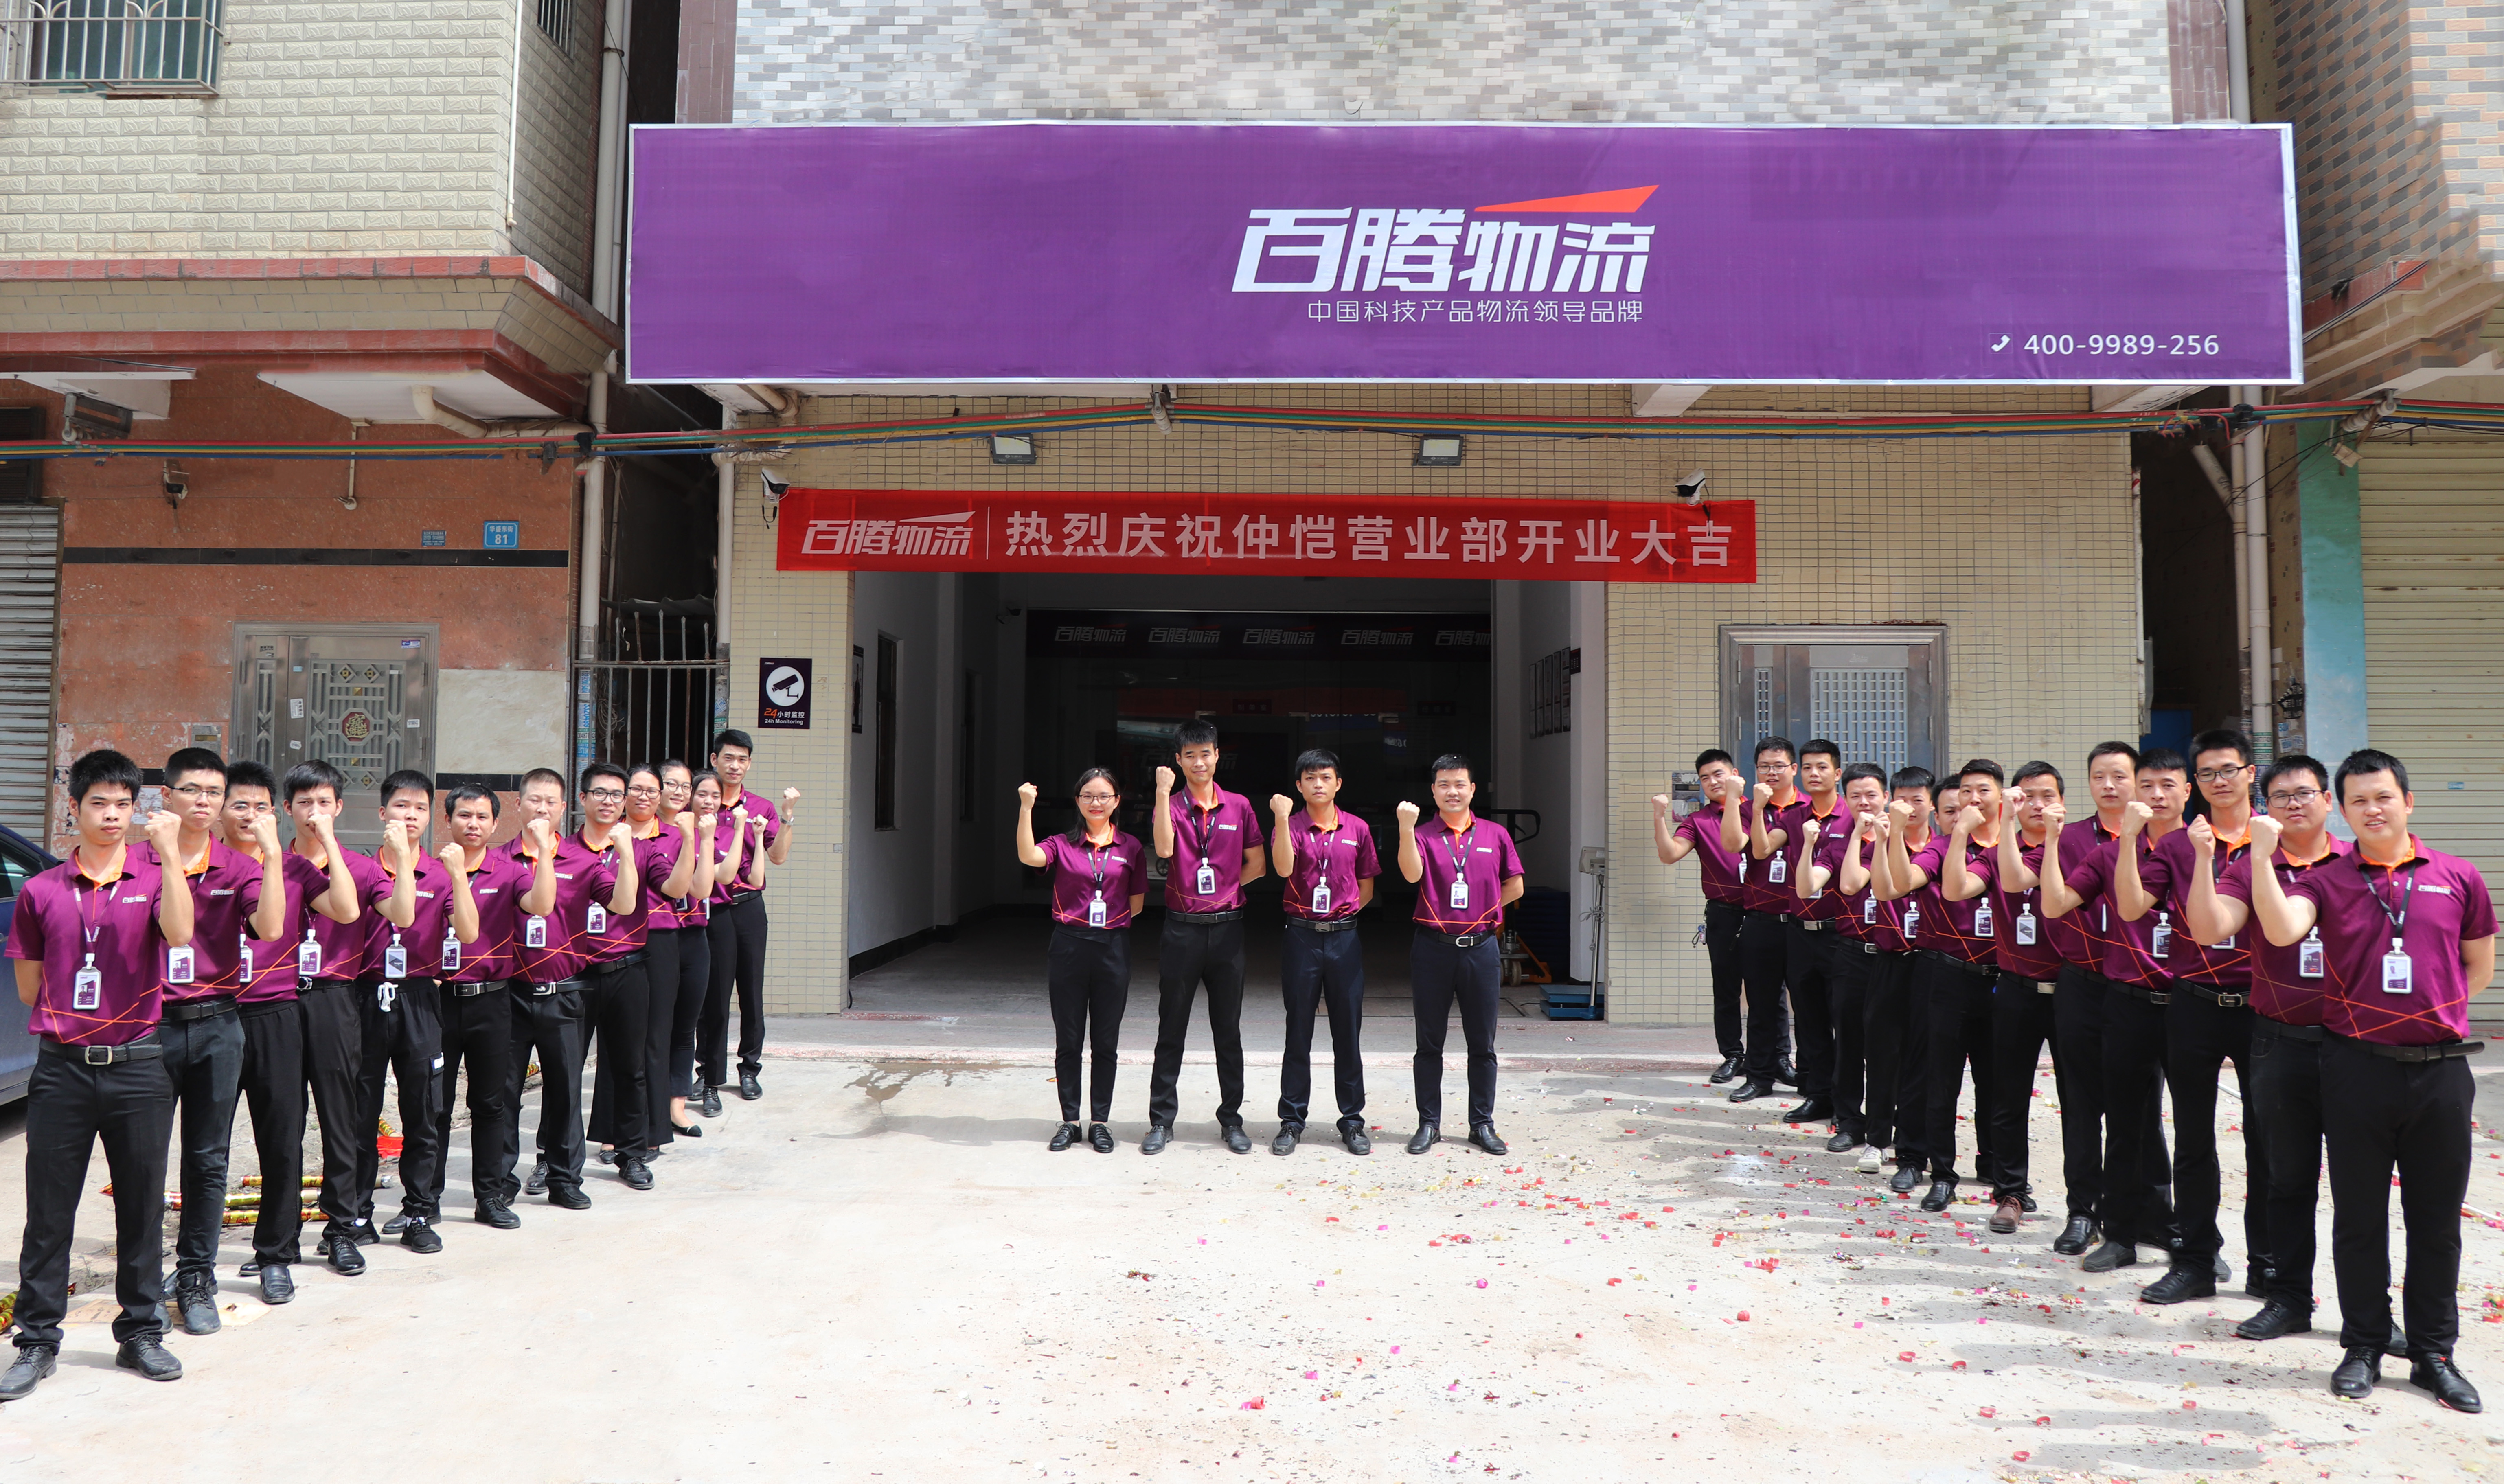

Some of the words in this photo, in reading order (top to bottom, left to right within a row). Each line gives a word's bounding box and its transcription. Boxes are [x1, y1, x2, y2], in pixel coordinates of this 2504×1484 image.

[1232, 207, 1655, 292] 百腾物流
[1307, 299, 1643, 323] 中国科技产品物流领导品牌
[2023, 334, 2219, 355] 400-9989-256
[495, 534, 508, 544] 81
[801, 519, 974, 555] 百腾物流
[1006, 511, 1732, 567] 热烈庆祝仲恺营业部开业大吉
[1054, 626, 1127, 642] 百腾物流
[1148, 627, 1221, 644] 百腾物流
[1243, 628, 1316, 645] 百腾物流
[1340, 629, 1414, 646] 百腾物流
[1435, 630, 1491, 647] 百腾物
[764, 708, 805, 719] 24小时监控
